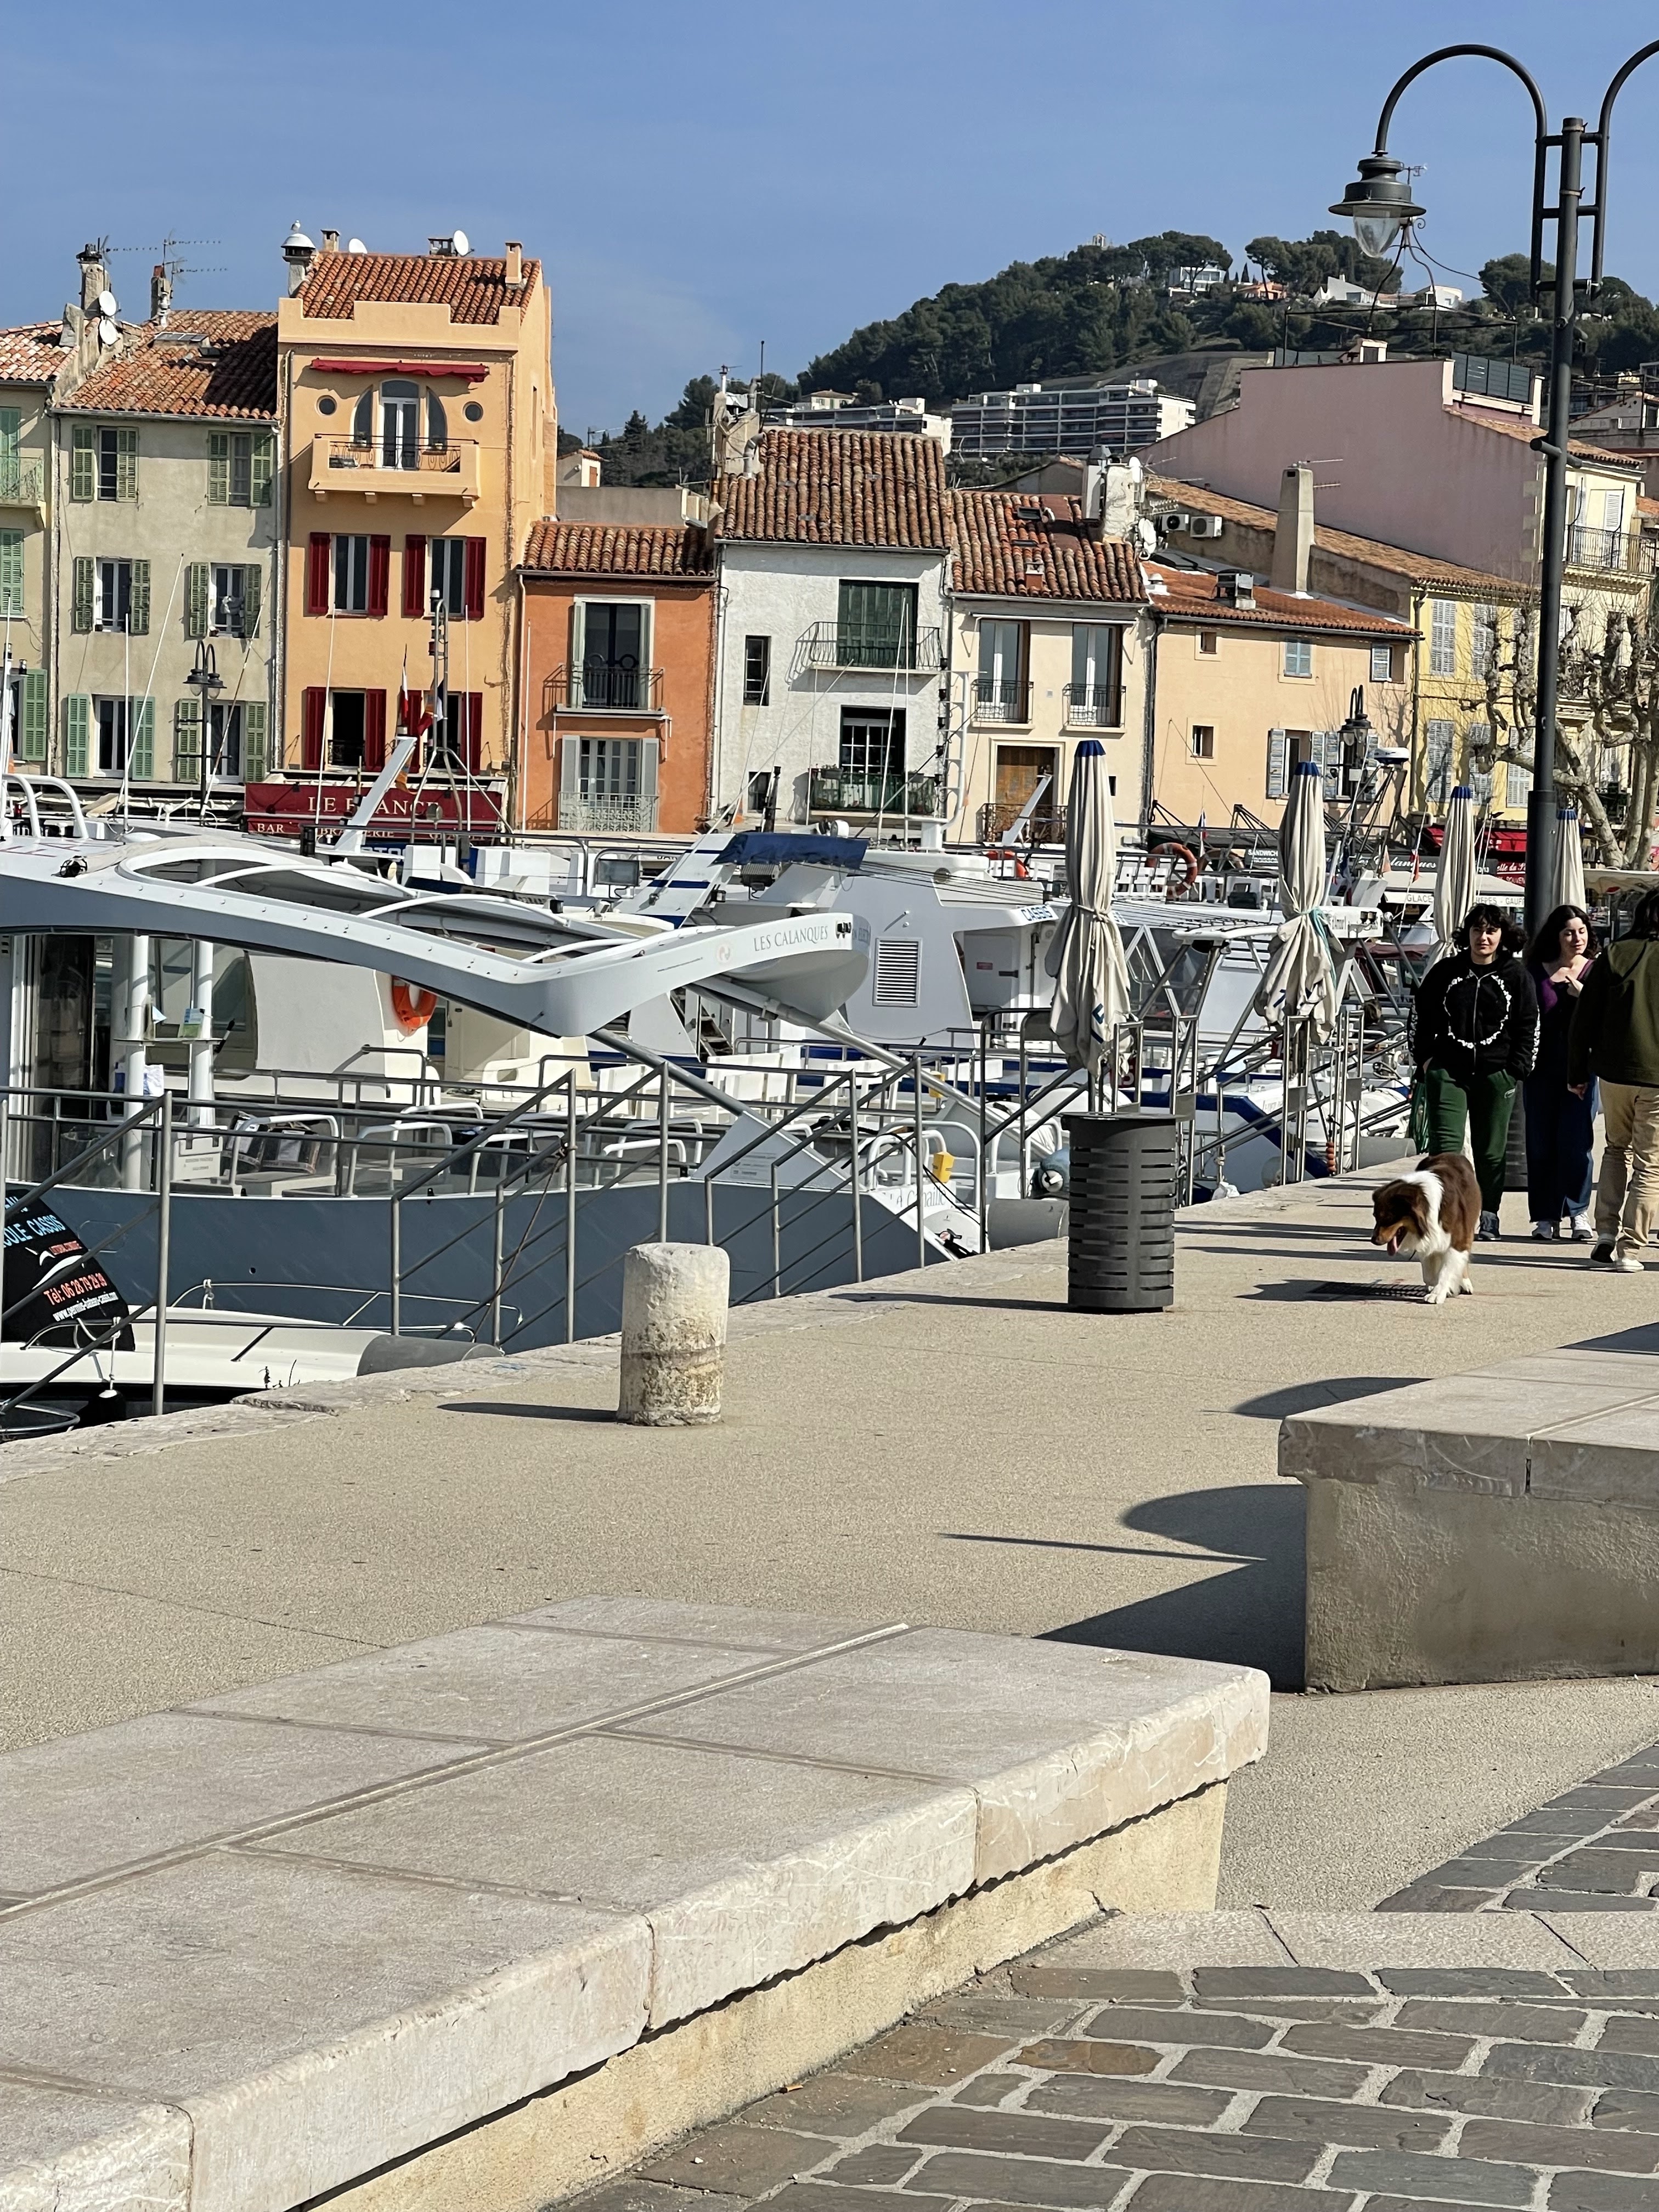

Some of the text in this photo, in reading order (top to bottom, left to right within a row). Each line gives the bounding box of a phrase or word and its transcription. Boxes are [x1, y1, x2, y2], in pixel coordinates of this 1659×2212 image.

[308, 796, 439, 816] LE FANC
[257, 823, 285, 834] BAR
[1020, 906, 1053, 921] CASSIS
[753, 926, 829, 952] LES CALANQUES
[26, 1214, 66, 1237] CASSIS
[43, 1287, 66, 1306] Tél:
[60, 1283, 76, 1299] 06
[70, 1279, 85, 1295] 28
